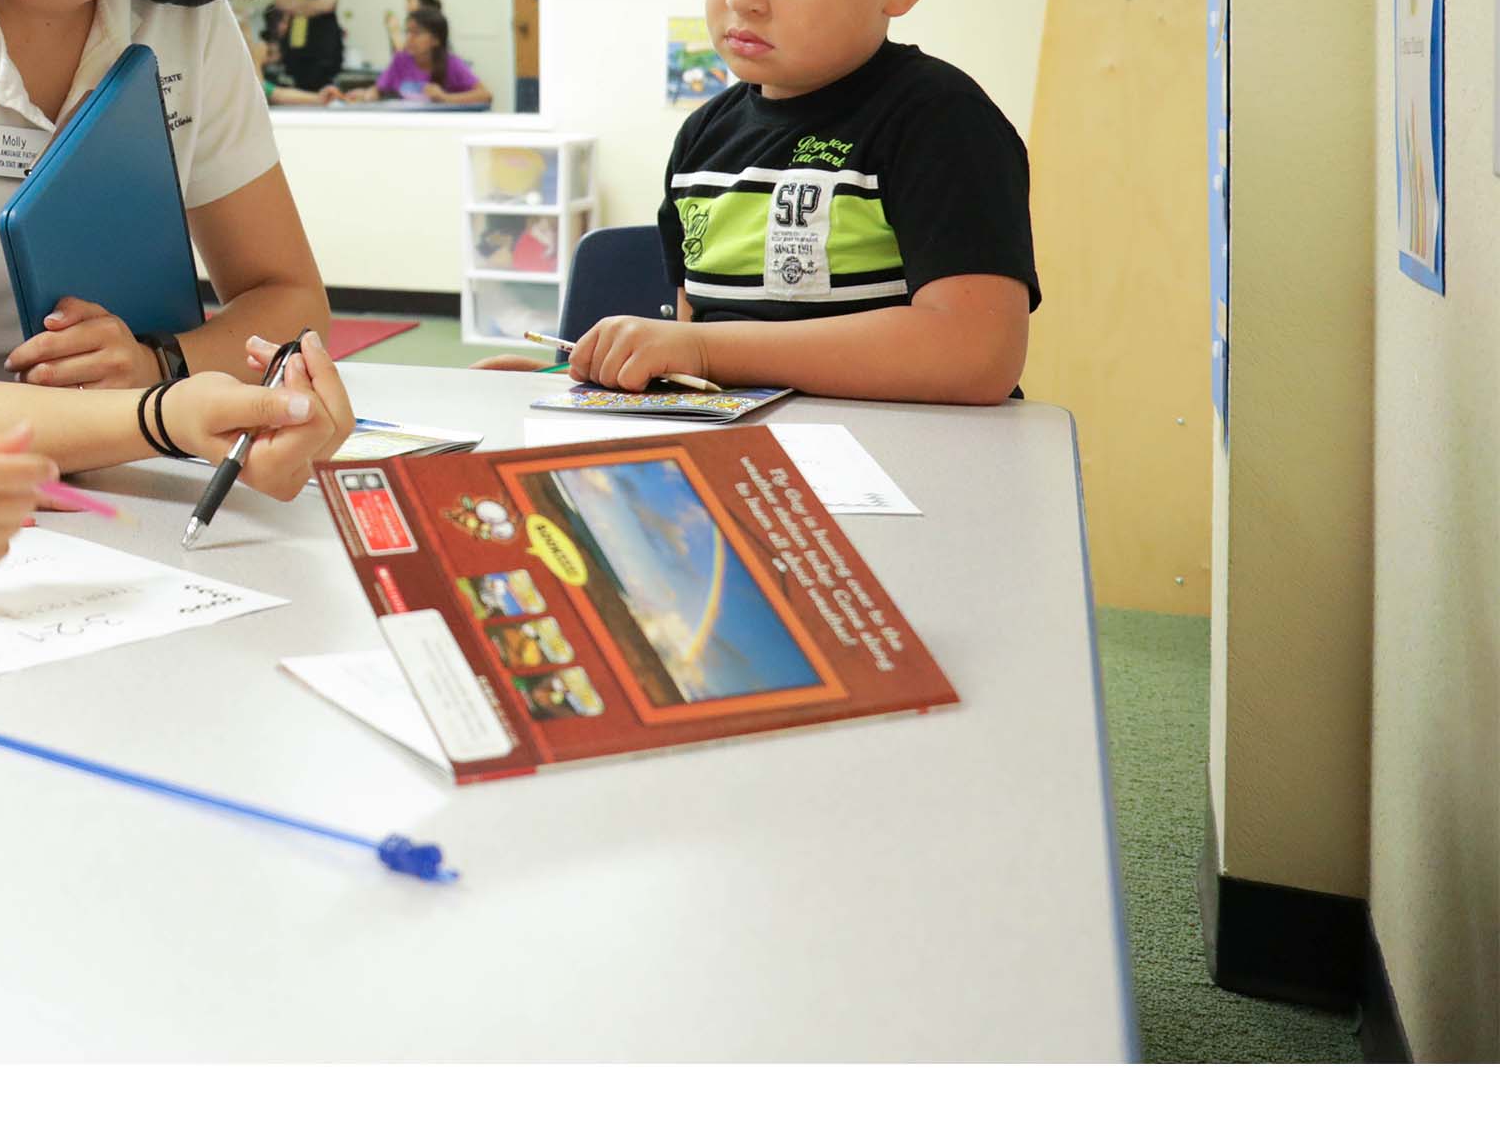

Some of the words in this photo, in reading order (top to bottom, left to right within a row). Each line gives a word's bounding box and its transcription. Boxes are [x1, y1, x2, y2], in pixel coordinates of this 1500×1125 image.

[2, 135, 27, 150] Molly
[775, 182, 822, 228] SP
[774, 243, 797, 255] SINCE
[740, 456, 778, 505] weather
[832, 589, 866, 630] Come
[769, 467, 789, 488] Fly
[784, 488, 809, 515] Guy
[881, 627, 904, 651] the
